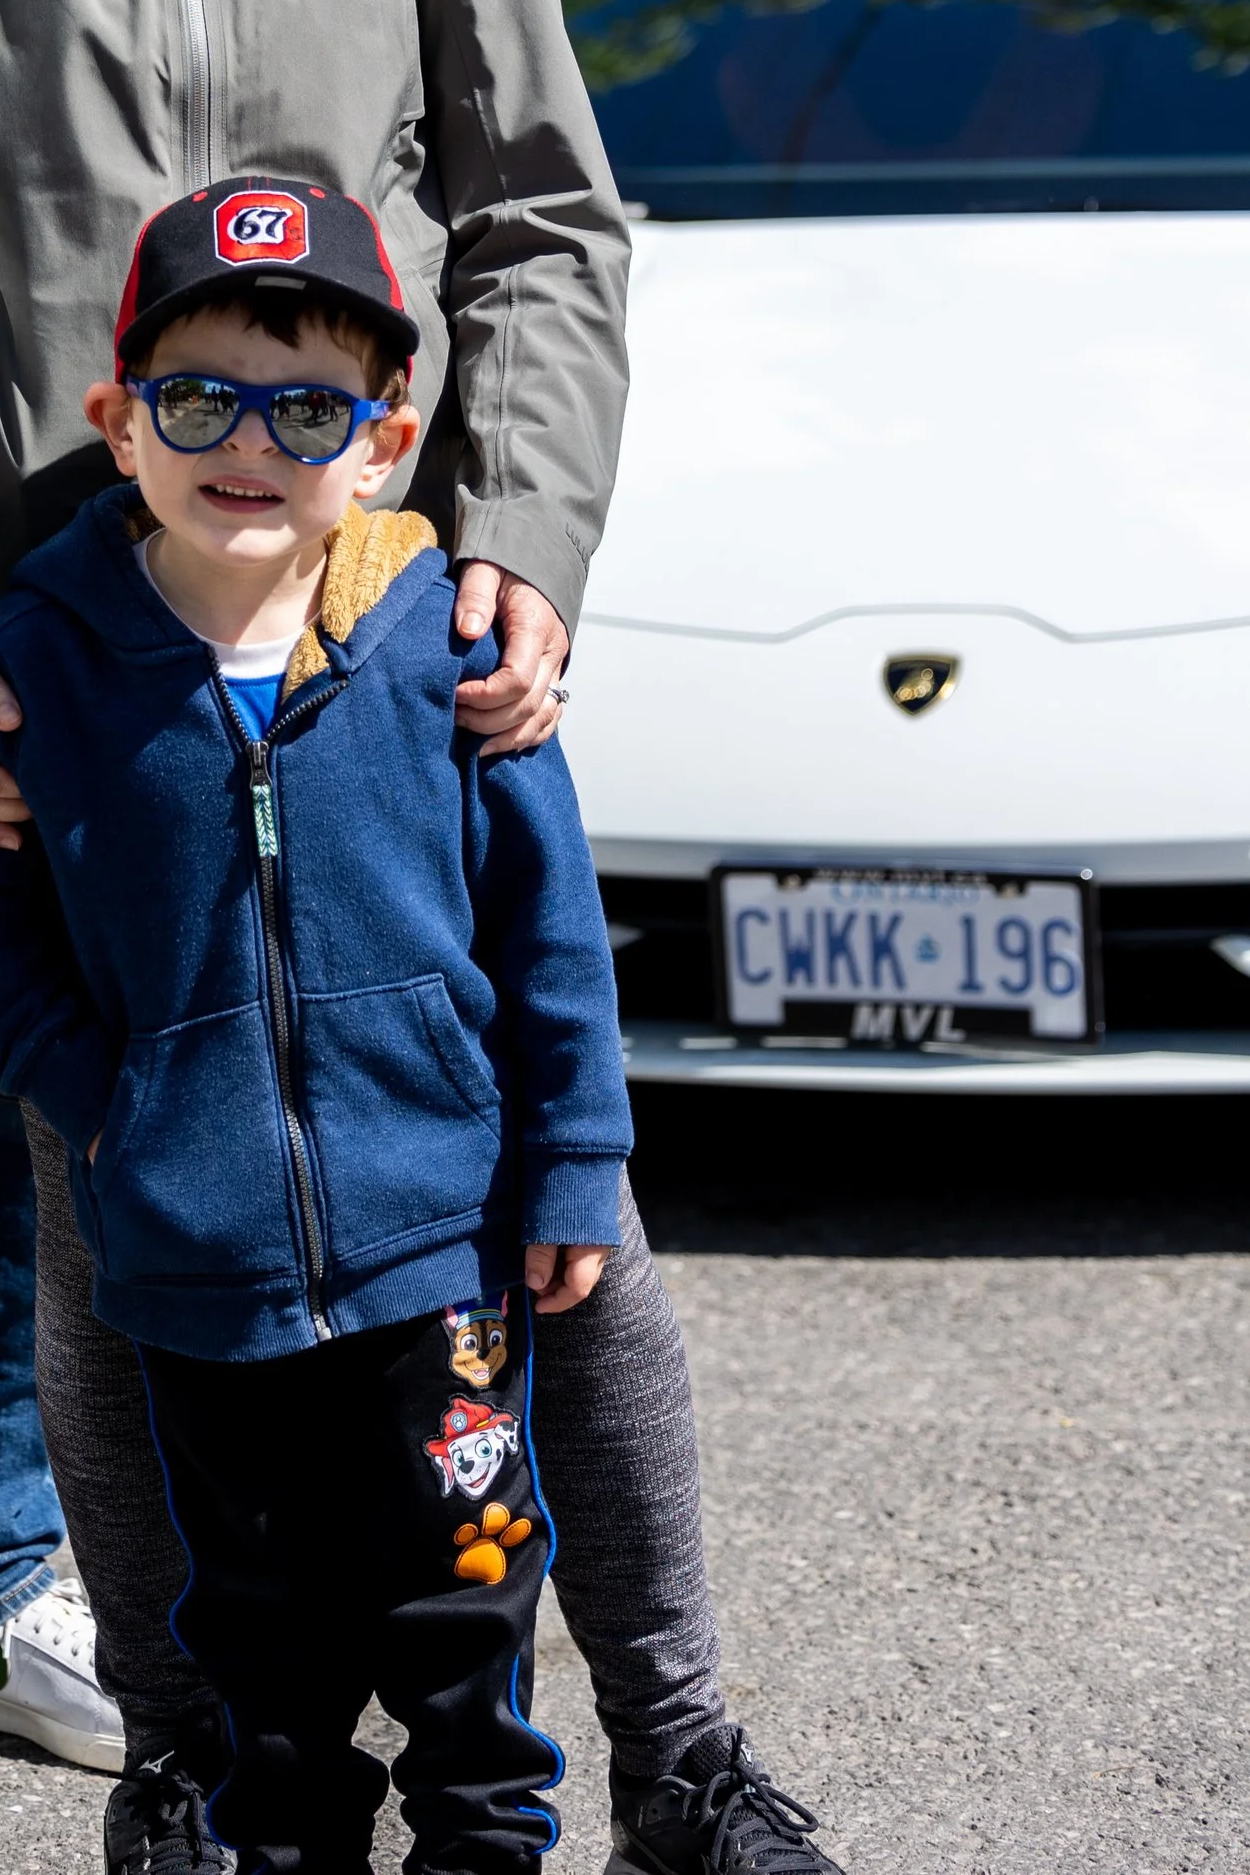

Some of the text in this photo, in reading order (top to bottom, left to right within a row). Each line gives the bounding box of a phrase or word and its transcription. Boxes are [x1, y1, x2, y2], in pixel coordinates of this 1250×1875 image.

[233, 208, 288, 241] 67
[735, 906, 1082, 996] CWKK 196
[852, 1002, 966, 1042] MVL
